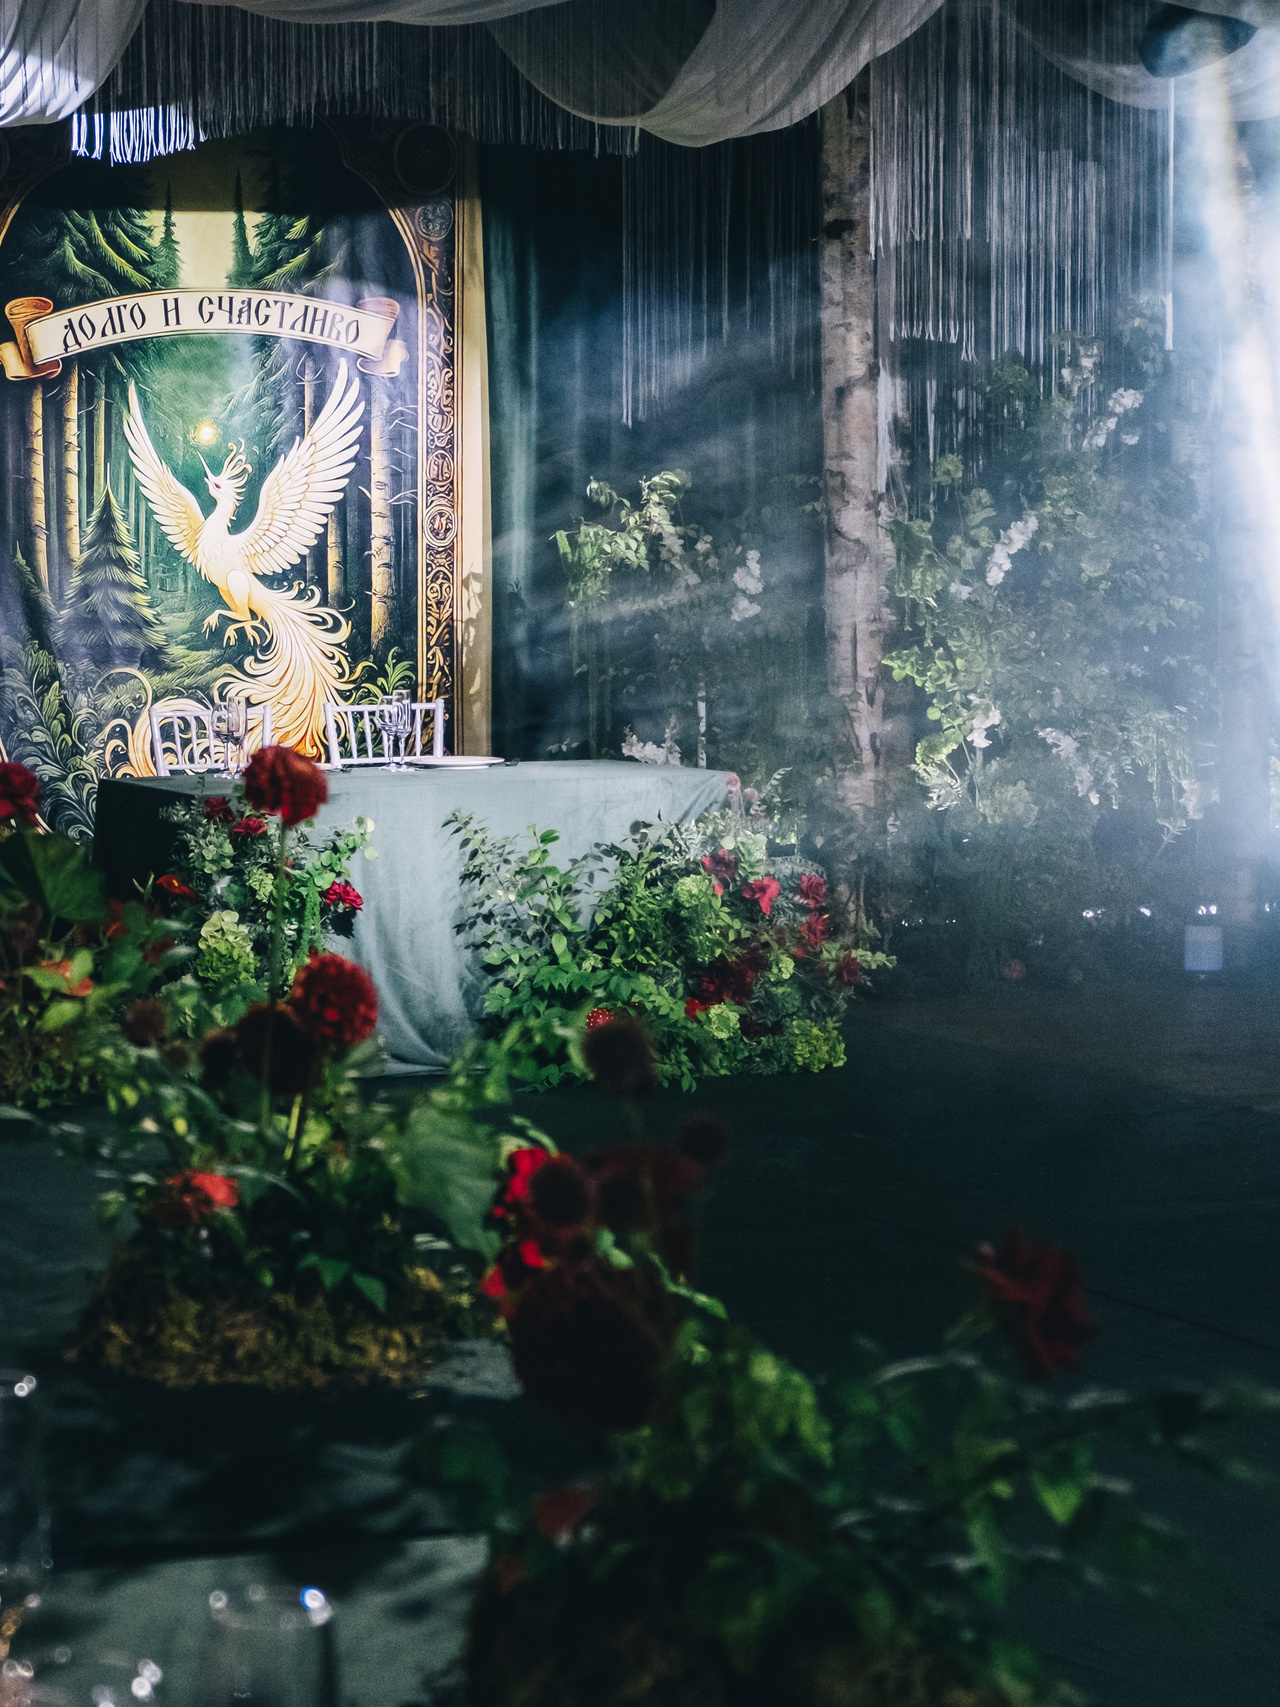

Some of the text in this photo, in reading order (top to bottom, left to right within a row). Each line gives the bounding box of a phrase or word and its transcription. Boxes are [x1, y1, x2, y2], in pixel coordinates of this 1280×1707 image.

[62, 295, 360, 352] ДОЛГО И СЧАСТЛИВО
